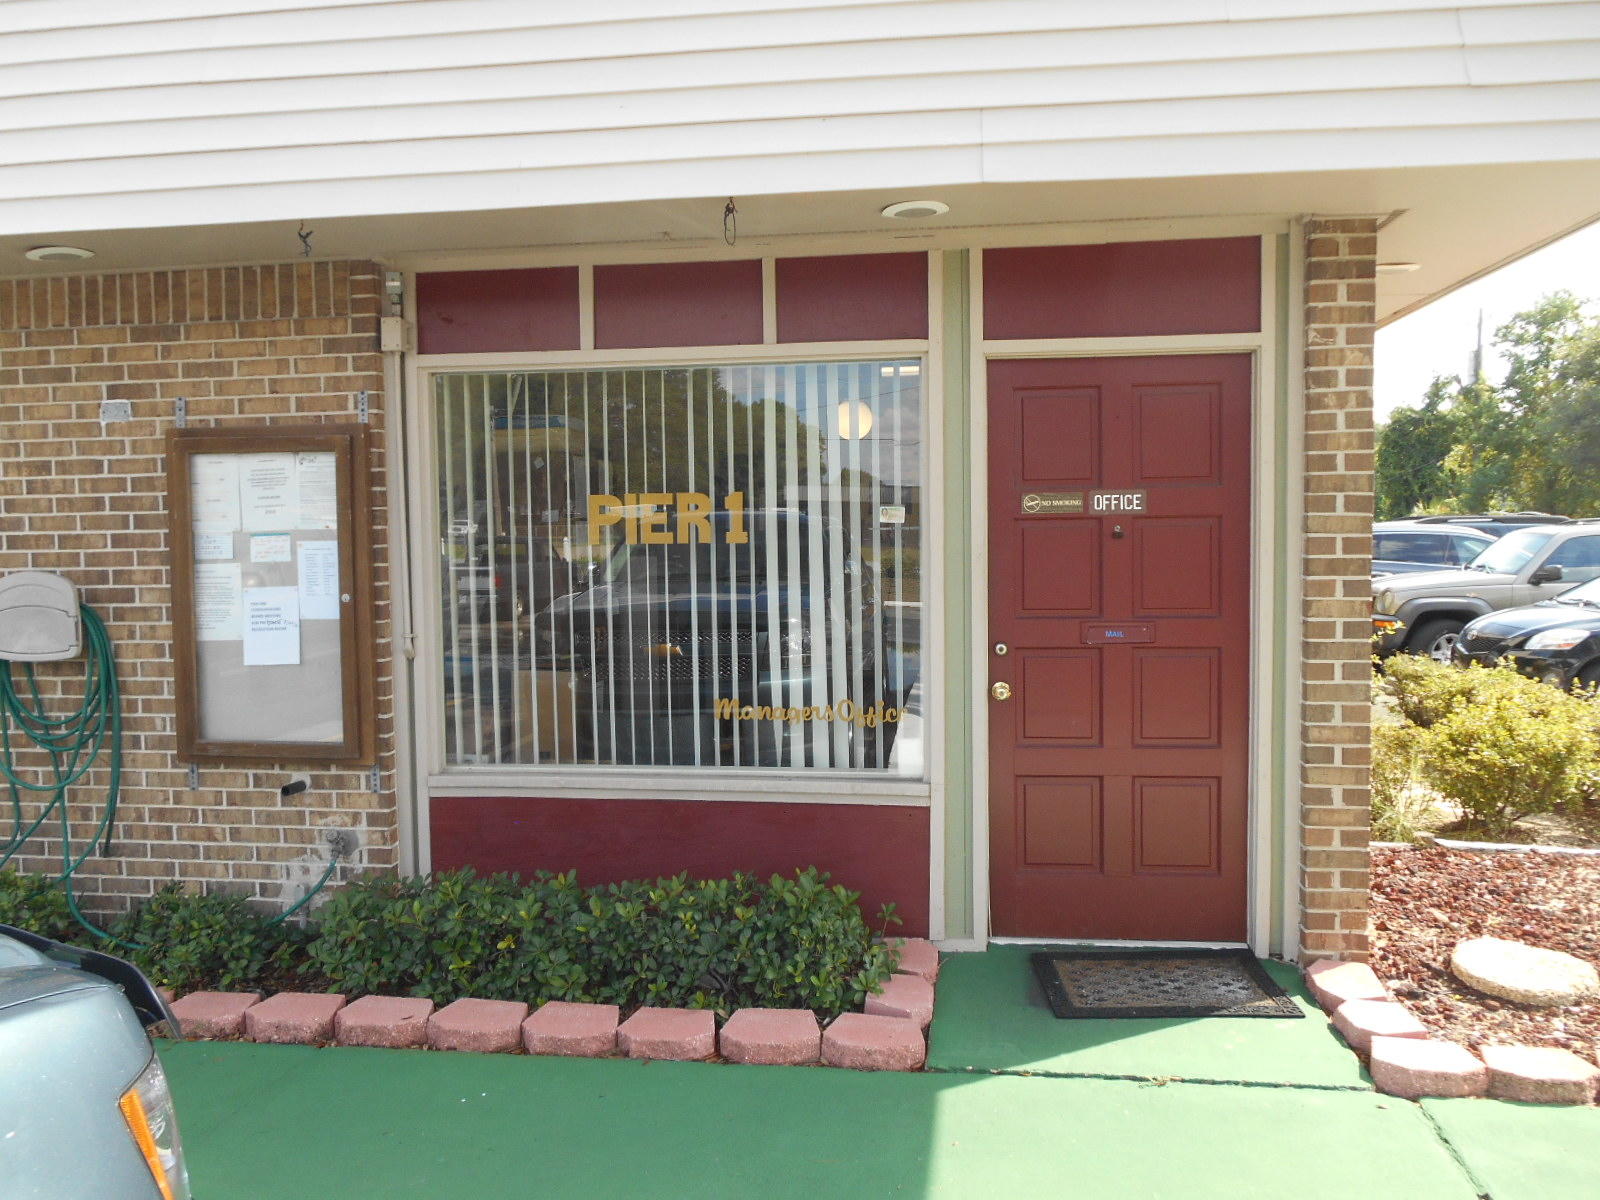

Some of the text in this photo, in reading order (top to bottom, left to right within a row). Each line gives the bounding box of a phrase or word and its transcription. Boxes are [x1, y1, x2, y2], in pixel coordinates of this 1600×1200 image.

[587, 491, 749, 544] PIER 1
[1094, 494, 1142, 510] OFFICE
